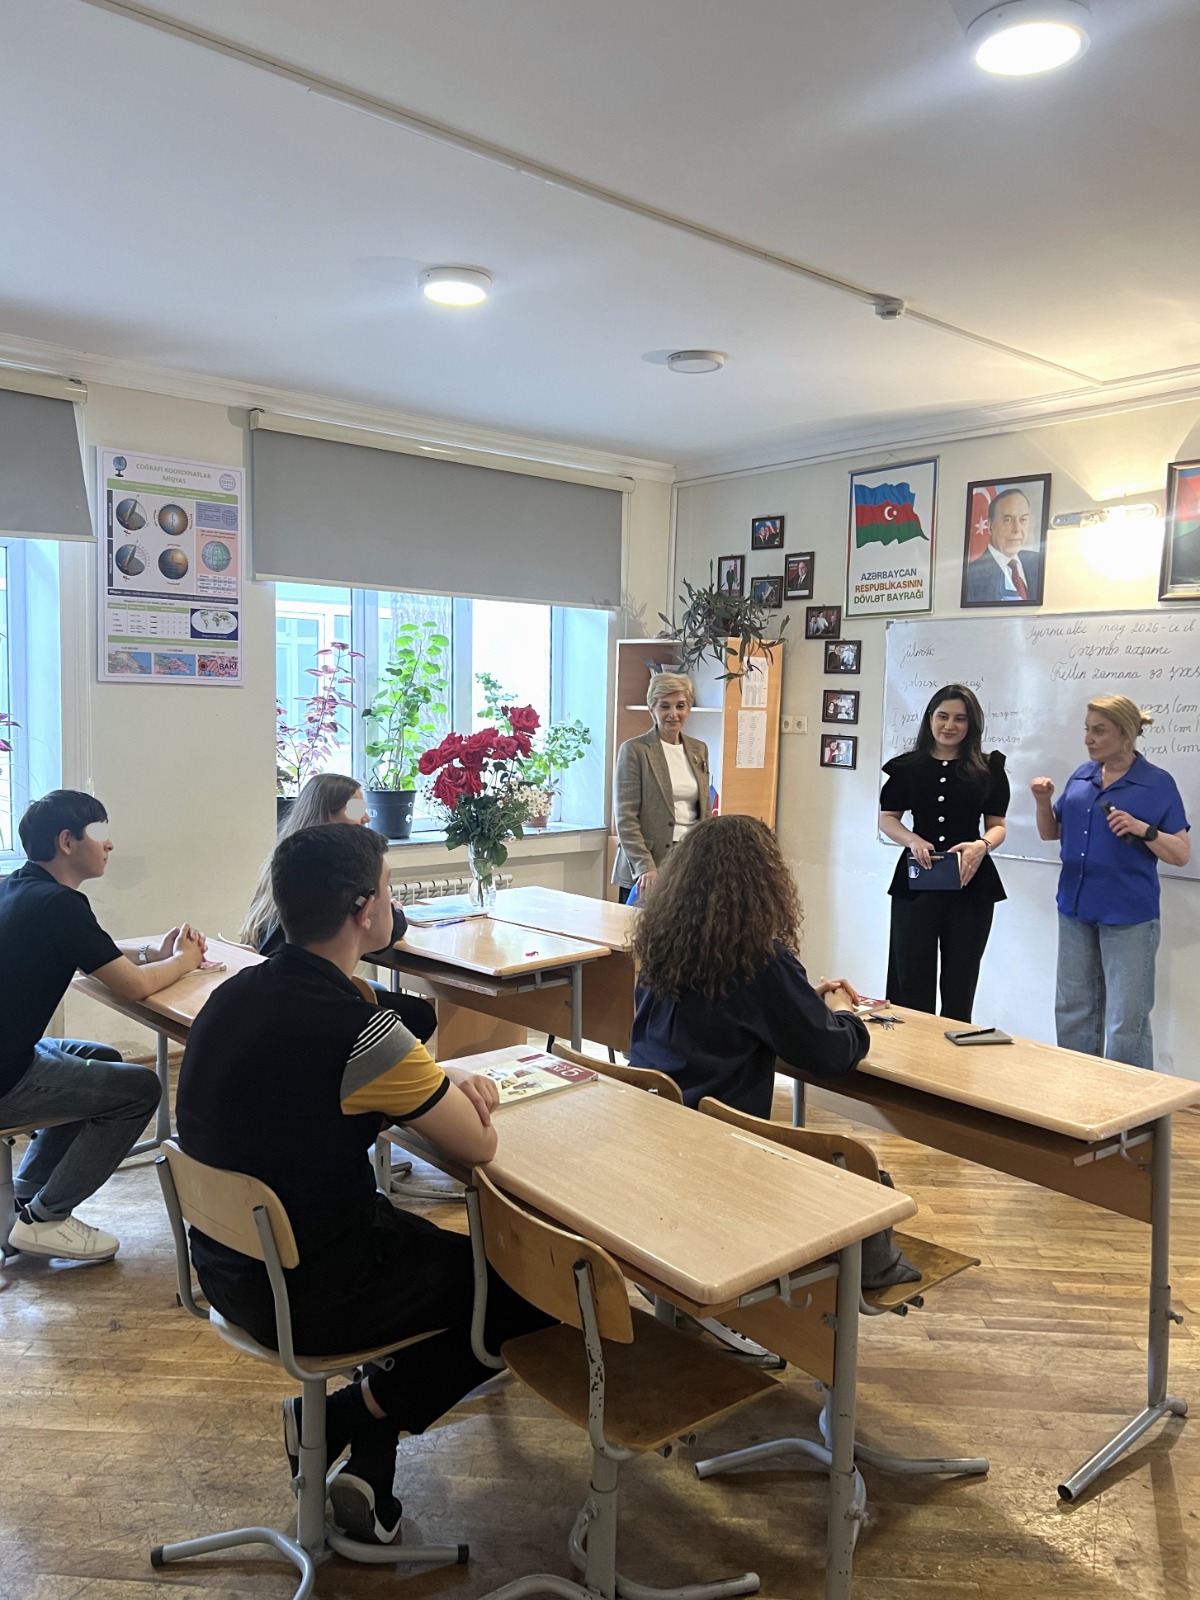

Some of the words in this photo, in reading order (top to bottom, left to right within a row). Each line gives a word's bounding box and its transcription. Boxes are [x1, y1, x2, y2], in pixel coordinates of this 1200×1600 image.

[162, 475, 187, 484] MİQYAS
[164, 467, 211, 479] KOORDİNATLAR
[860, 568, 917, 581] AZƏRBAYCAN
[855, 579, 923, 593] RESPUBLİKASININ
[854, 593, 885, 604] DÖVLƏT
[886, 590, 924, 602] BAYRAĞI
[1099, 624, 1126, 641] may
